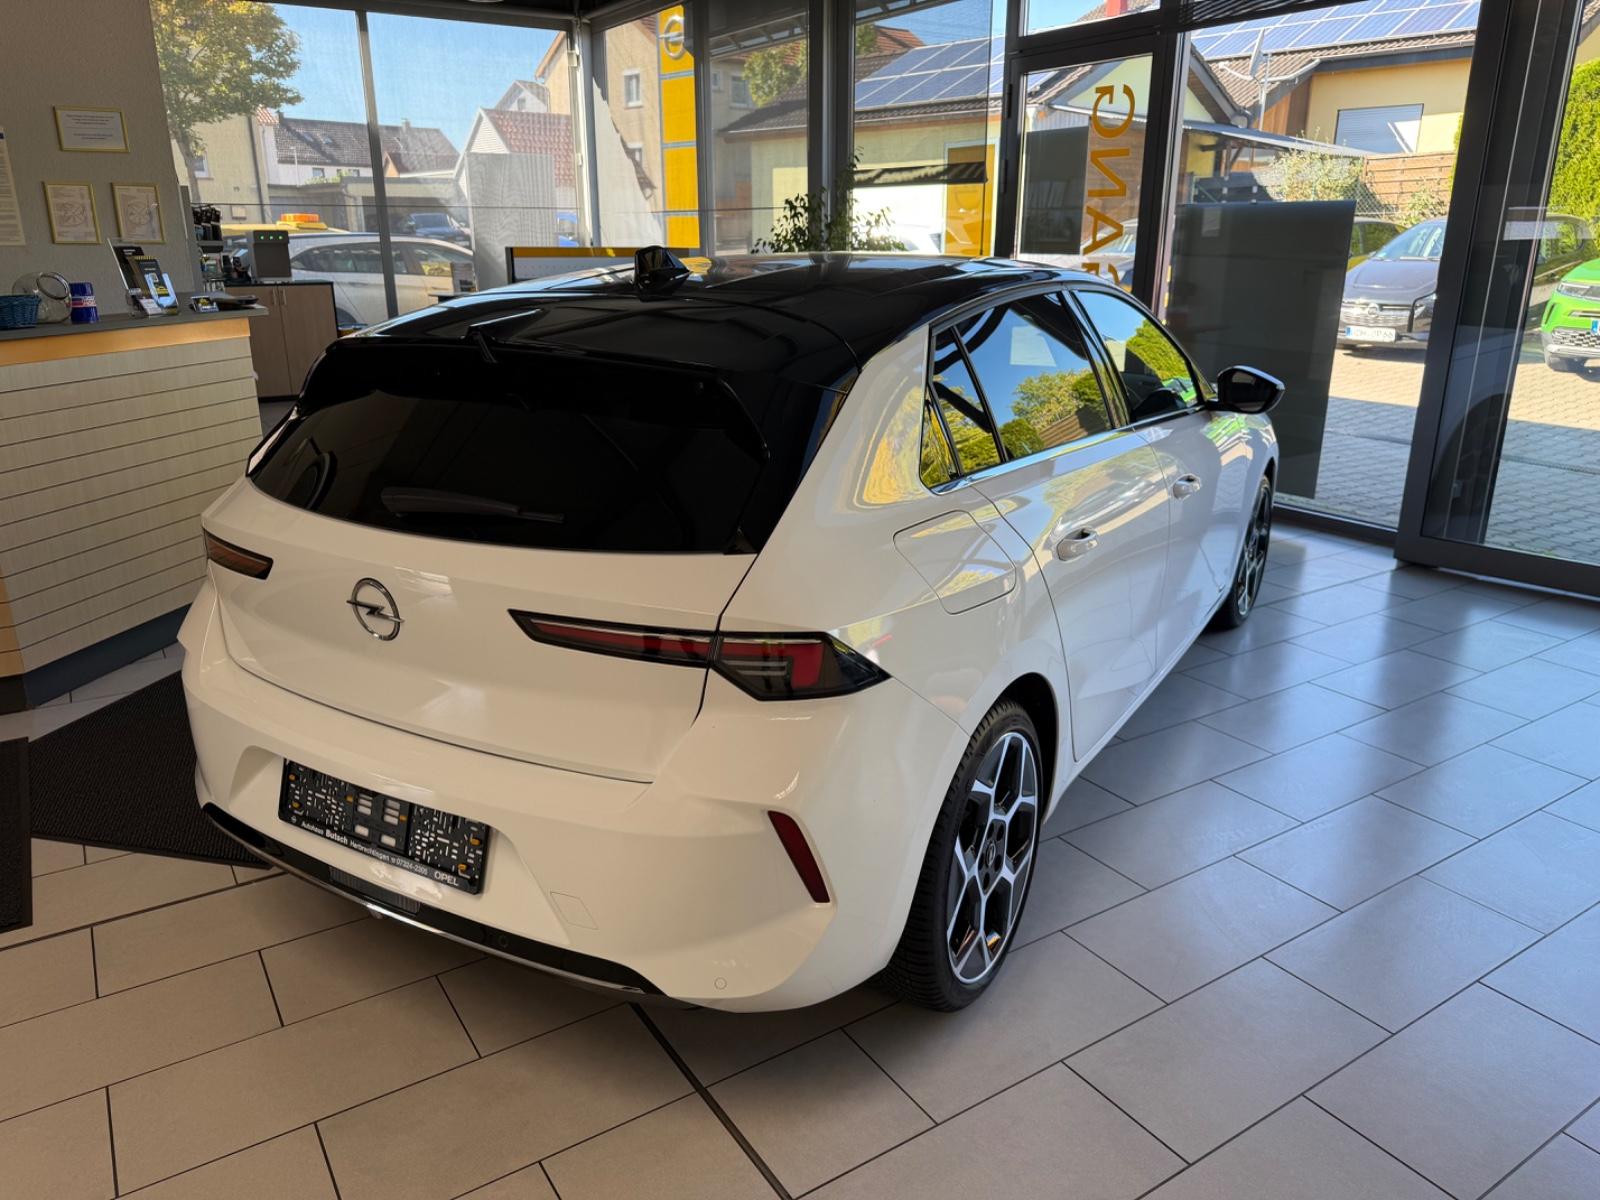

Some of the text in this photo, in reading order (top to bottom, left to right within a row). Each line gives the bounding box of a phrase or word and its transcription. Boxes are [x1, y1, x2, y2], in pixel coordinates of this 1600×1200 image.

[301, 821, 324, 835] Autohaus
[325, 829, 348, 845] Butsch
[350, 840, 390, 861] Herbrechtingen
[434, 871, 459, 887] OPEL
